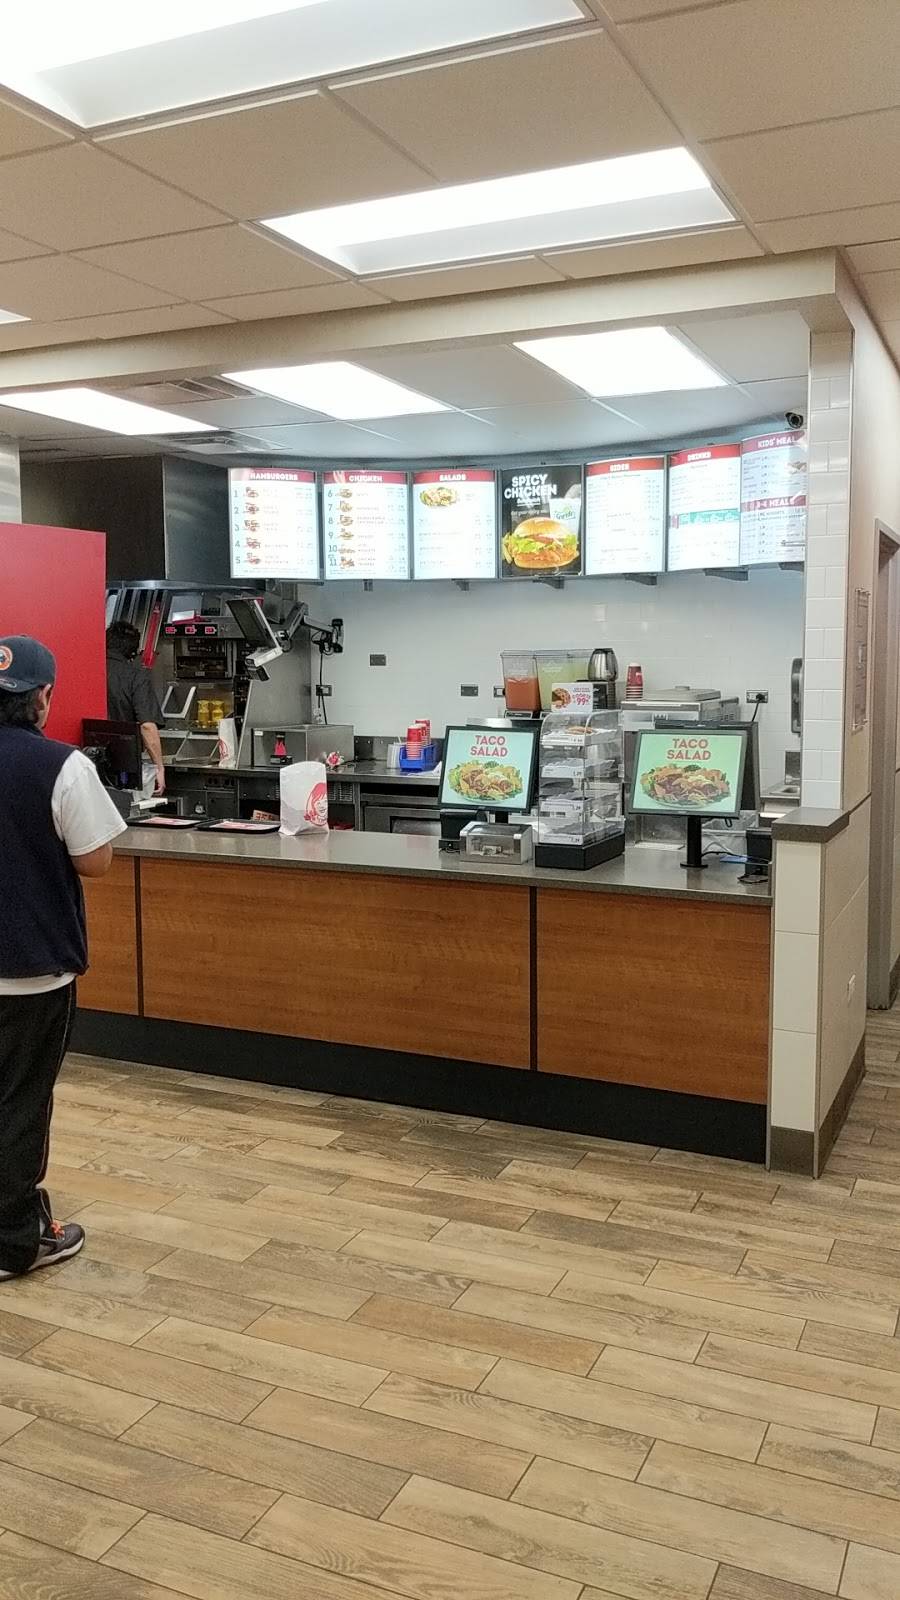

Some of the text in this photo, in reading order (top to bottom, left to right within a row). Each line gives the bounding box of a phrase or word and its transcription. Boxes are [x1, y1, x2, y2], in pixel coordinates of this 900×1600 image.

[249, 472, 298, 481] HAMBURGERS
[511, 473, 548, 487] SPICY
[504, 483, 557, 499] CHICKEN
[474, 735, 506, 746] TACO
[672, 738, 708, 749] TACO
[470, 745, 508, 757] SALAD
[666, 749, 711, 761] SALAD
